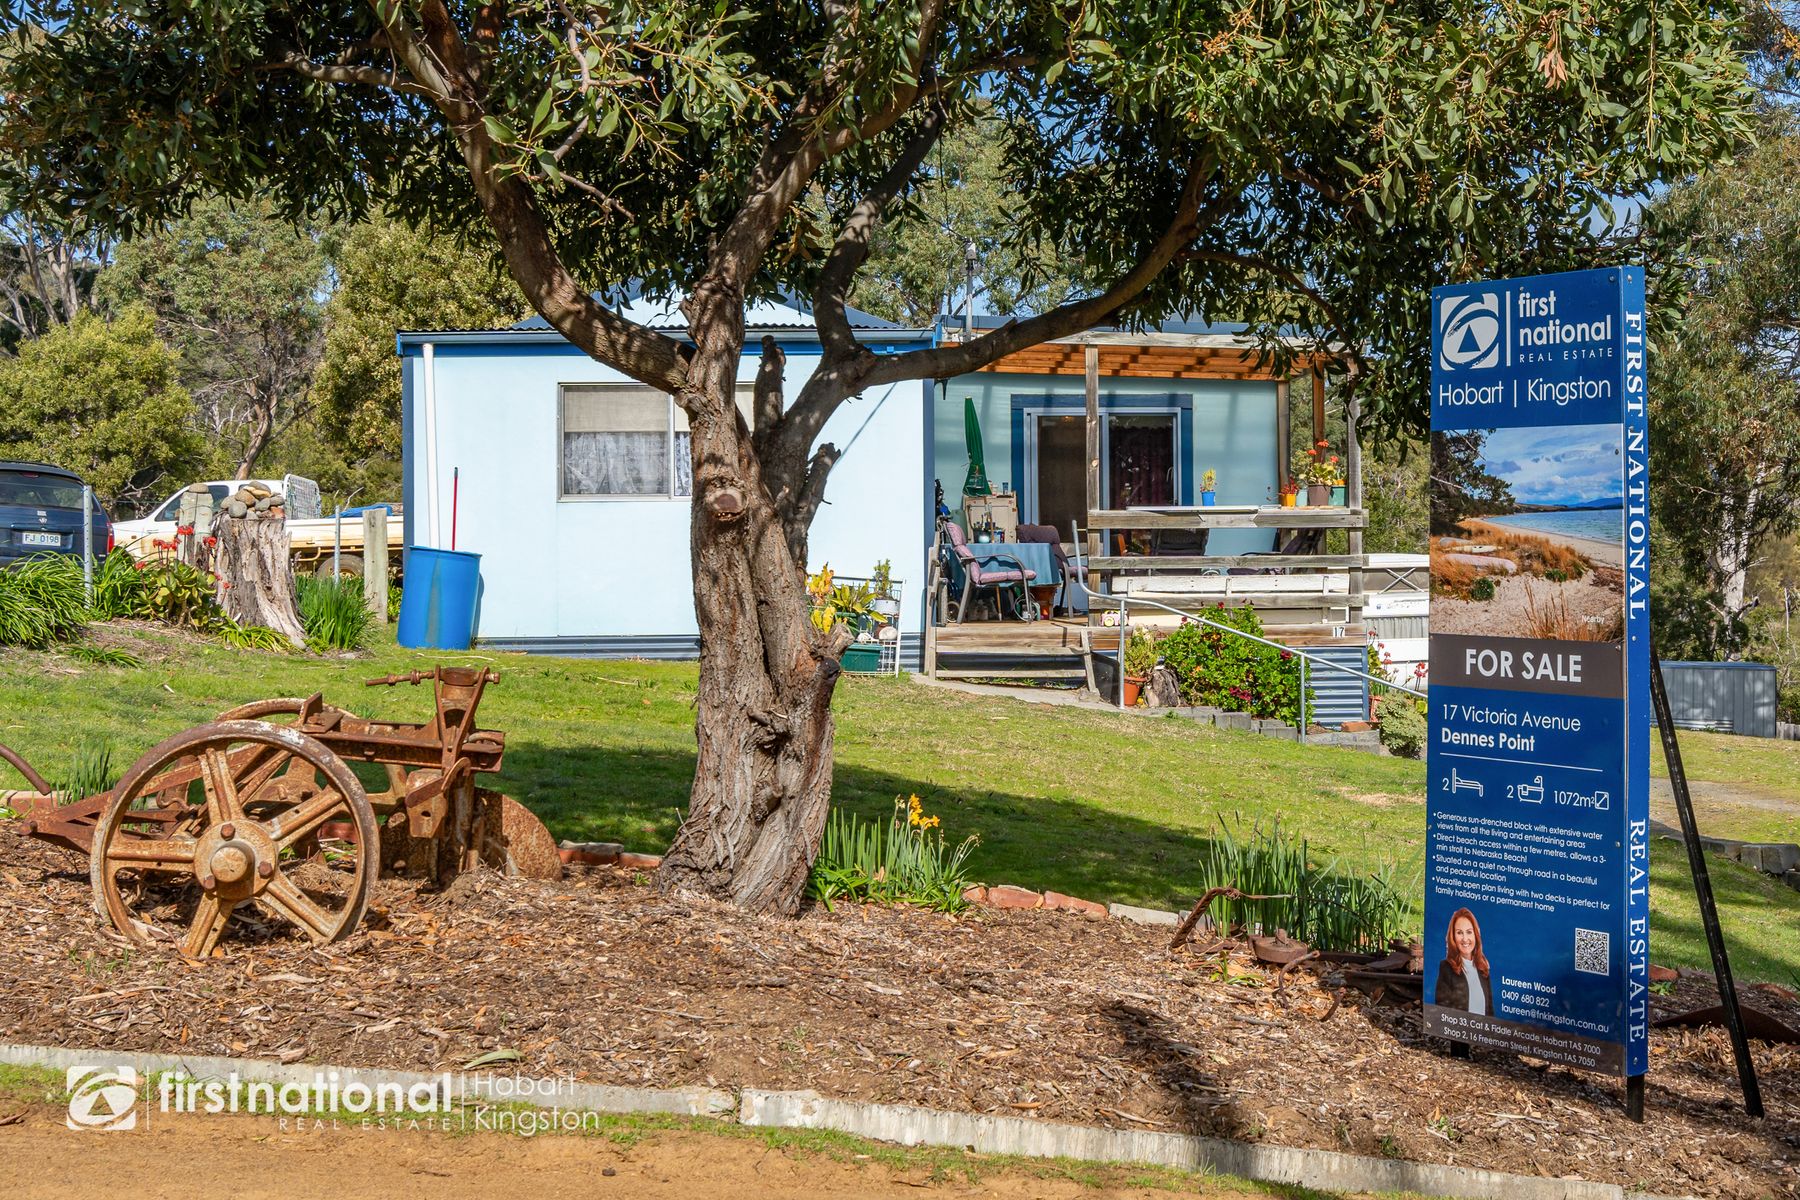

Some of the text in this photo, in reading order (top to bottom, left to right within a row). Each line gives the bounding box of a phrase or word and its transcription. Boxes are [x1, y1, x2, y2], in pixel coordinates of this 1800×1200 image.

[1518, 290, 1556, 318] first
[1520, 315, 1611, 346] national
[1520, 347, 1613, 363] REAL ESTATE
[1440, 376, 1611, 406] Hobart Kingston
[1626, 311, 1646, 620] FIRST NATIONAL
[1335, 627, 1344, 638] 17
[1582, 615, 1605, 624] Nearby
[1466, 649, 1581, 682] FOR SALE
[1443, 704, 1581, 731] 17 Victoria Avenue
[1442, 728, 1535, 751] Dennes Point
[1442, 778, 1449, 791] 2
[1507, 785, 1514, 798] 2
[1437, 811, 1603, 840] Generous sun-drenched block with extensive water
[1437, 822, 1586, 849] views from all the living and entertaining areas
[1437, 833, 1455, 842] Direct
[1456, 835, 1477, 845] beach
[1479, 840, 1501, 849] access
[1502, 842, 1522, 851] within
[1529, 846, 1542, 854] few
[1570, 852, 1591, 862] allows
[1449, 845, 1463, 853] stroll
[1464, 847, 1471, 855] to
[1472, 848, 1502, 859] Nebraska
[1436, 854, 1462, 865] Situated
[1479, 861, 1496, 870] quiet
[1496, 864, 1533, 877] no-through
[1535, 870, 1551, 879] road
[1552, 871, 1559, 879] in
[1566, 873, 1597, 885] beautiful
[1436, 865, 1506, 882] and peaceful location
[1435, 876, 1610, 910] Versatile open plan living with two decks is perfect for
[1435, 886, 1454, 897] family
[1455, 889, 1481, 901] holidays
[1496, 896, 1533, 908] permanent
[1535, 902, 1555, 912] home
[1630, 819, 1645, 1042] REAL ESTATE
[1501, 990, 1549, 1007] 0409 680 822
[1502, 976, 1556, 994] Laureen Wood
[1501, 1003, 1609, 1033] laureen@fnkingston.com.au
[1441, 1014, 1458, 1025] Shop
[1470, 1020, 1483, 1029] Cat
[1491, 1025, 1511, 1036] Fiddle
[1543, 1036, 1568, 1047] Hobart
[1569, 1041, 1581, 1051] TAS
[1584, 1044, 1600, 1054] 7000
[1444, 1027, 1461, 1038] Shop
[1478, 1035, 1509, 1049] Freeman
[1533, 1046, 1563, 1060] Kingston
[1564, 1053, 1577, 1063] TAS
[1579, 1056, 1595, 1067] 7050
